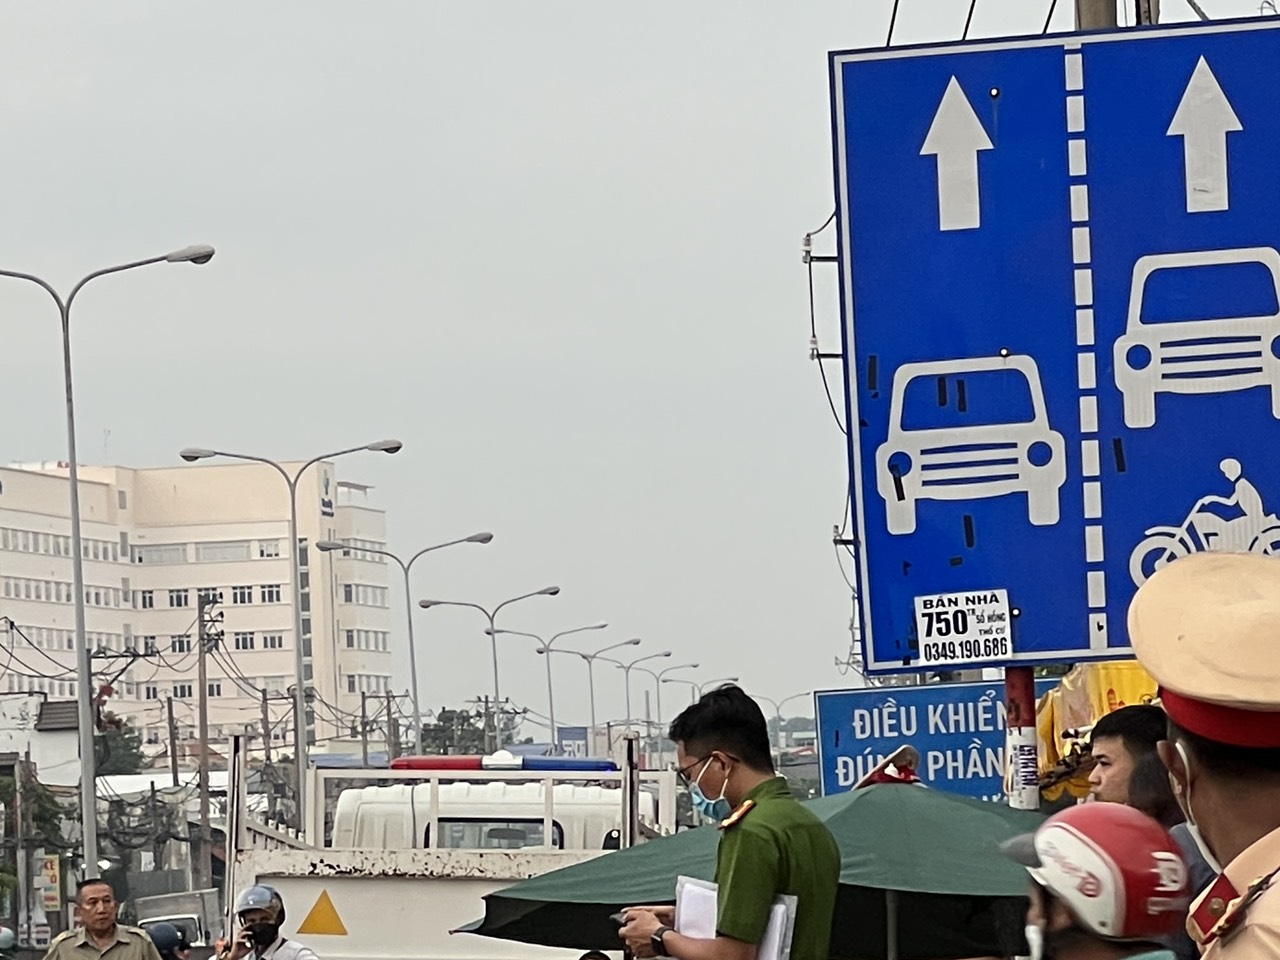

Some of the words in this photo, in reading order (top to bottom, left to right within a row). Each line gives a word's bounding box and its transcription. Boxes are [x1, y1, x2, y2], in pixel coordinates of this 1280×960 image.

[922, 595, 959, 609] BÁN
[964, 591, 1000, 606] NHÀ
[921, 609, 968, 637] 750
[923, 636, 1008, 662] 0349.190.686
[852, 697, 917, 740] ĐIỀU
[927, 738, 1005, 782] PHẦN
